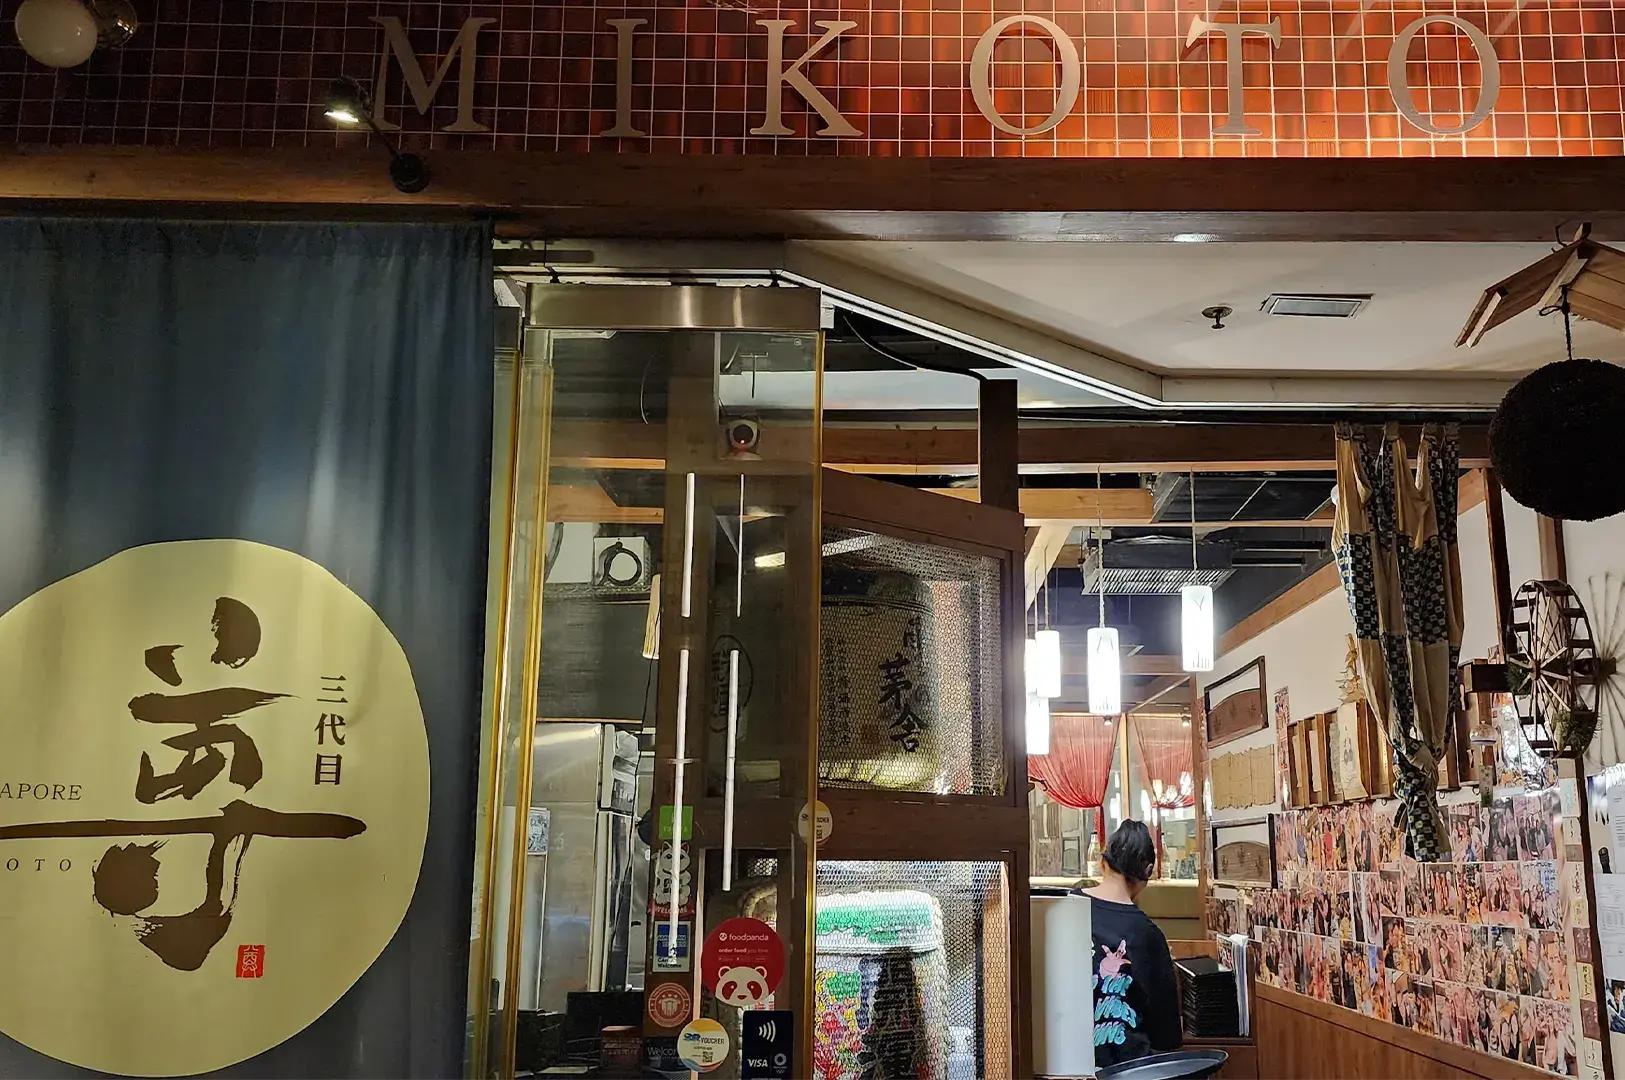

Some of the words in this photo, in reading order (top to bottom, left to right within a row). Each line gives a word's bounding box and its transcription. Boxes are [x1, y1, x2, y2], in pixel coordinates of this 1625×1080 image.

[368, 14, 1500, 137] MIKOTO
[314, 674, 348, 786] 三代目
[655, 905, 688, 914] WELCME
[729, 932, 769, 942] foodpanda
[700, 1037, 725, 1045] VOUCHER
[647, 1046, 677, 1056] Welco
[747, 1059, 768, 1067] VISA
